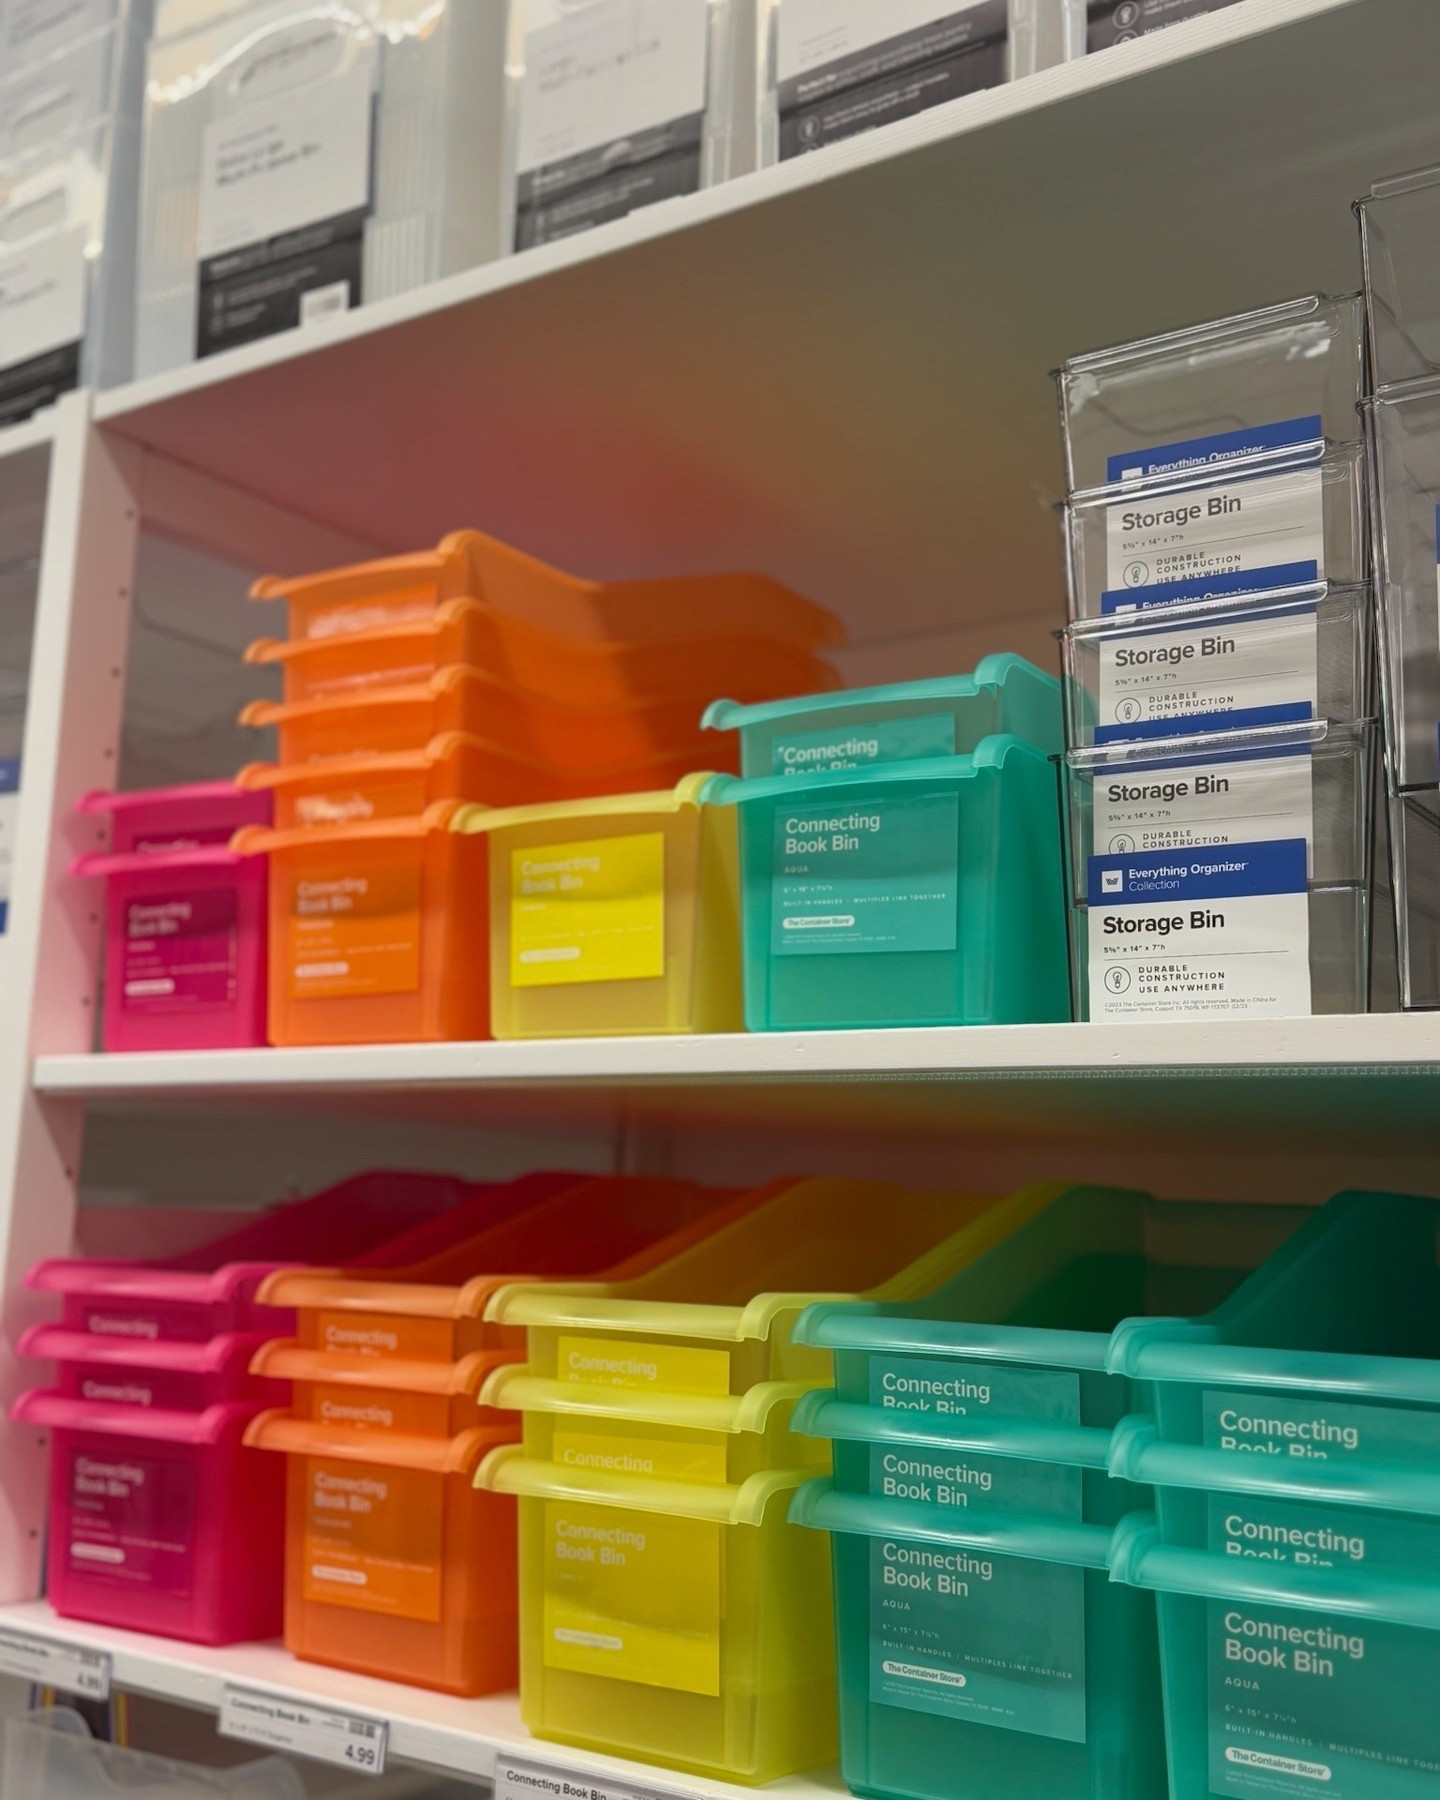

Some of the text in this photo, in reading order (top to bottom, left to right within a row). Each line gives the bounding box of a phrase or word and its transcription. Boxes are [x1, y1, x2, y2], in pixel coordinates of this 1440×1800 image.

[1122, 495, 1241, 531] Storage Bin
[1156, 551, 1205, 566] DURABLE
[1156, 554, 1241, 574] CONSTRUCTION
[1181, 565, 1240, 581] ANYWHERE
[1115, 636, 1235, 666] Storage Bin
[1149, 691, 1198, 703] DURABLE
[1149, 696, 1234, 711] CONSTRUCTION
[784, 738, 878, 764] Connecting
[1108, 774, 1229, 802] Storage Bin
[785, 813, 880, 834] Connecting
[1143, 829, 1192, 840] DURABLE
[785, 834, 859, 854] Book Bin
[1143, 835, 1229, 849] CONSTRUCTION
[784, 865, 809, 874] AQUA
[1128, 861, 1247, 879] Everything Organizer
[1129, 879, 1180, 892] Collection
[800, 918, 831, 926] Container
[1103, 909, 1225, 935] Storage Bin
[1139, 964, 1188, 974] DURABLE
[1139, 971, 1225, 983] CONSTRUCTION
[1139, 982, 1225, 993] USE ANYWHERE
[569, 1352, 657, 1380] Connecting
[882, 1373, 990, 1404] Connecting
[1220, 1410, 1358, 1449] Connecting
[564, 1449, 653, 1473] Connecting
[882, 1454, 992, 1491] Connecting
[883, 1477, 968, 1507] Book Bin
[556, 1520, 645, 1550] Connecting
[1225, 1515, 1364, 1560] Connecting
[556, 1541, 626, 1566] Book Bin
[883, 1542, 993, 1581] Connecting
[883, 1566, 969, 1597] Book Bin
[883, 1599, 911, 1611] AQUA
[1224, 1612, 1364, 1659] Connecting
[917, 1646, 952, 1659] HANDLES
[965, 1655, 1007, 1669] MULTIPLES
[1009, 1662, 1027, 1672] LINK
[1030, 1666, 1073, 1680] TOGETHER
[1225, 1638, 1334, 1677] Book Bin
[887, 1663, 961, 1684] The Container Store
[1225, 1676, 1260, 1691] AQUA
[345, 1744, 375, 1766] 4.99
[1269, 1731, 1312, 1746] HANDLES
[1329, 1743, 1382, 1760] MULTIPLES
[1386, 1754, 1409, 1765] LINK
[1232, 1750, 1324, 1777] The Container Store
[506, 1770, 607, 1800] Connecting Book Bin
